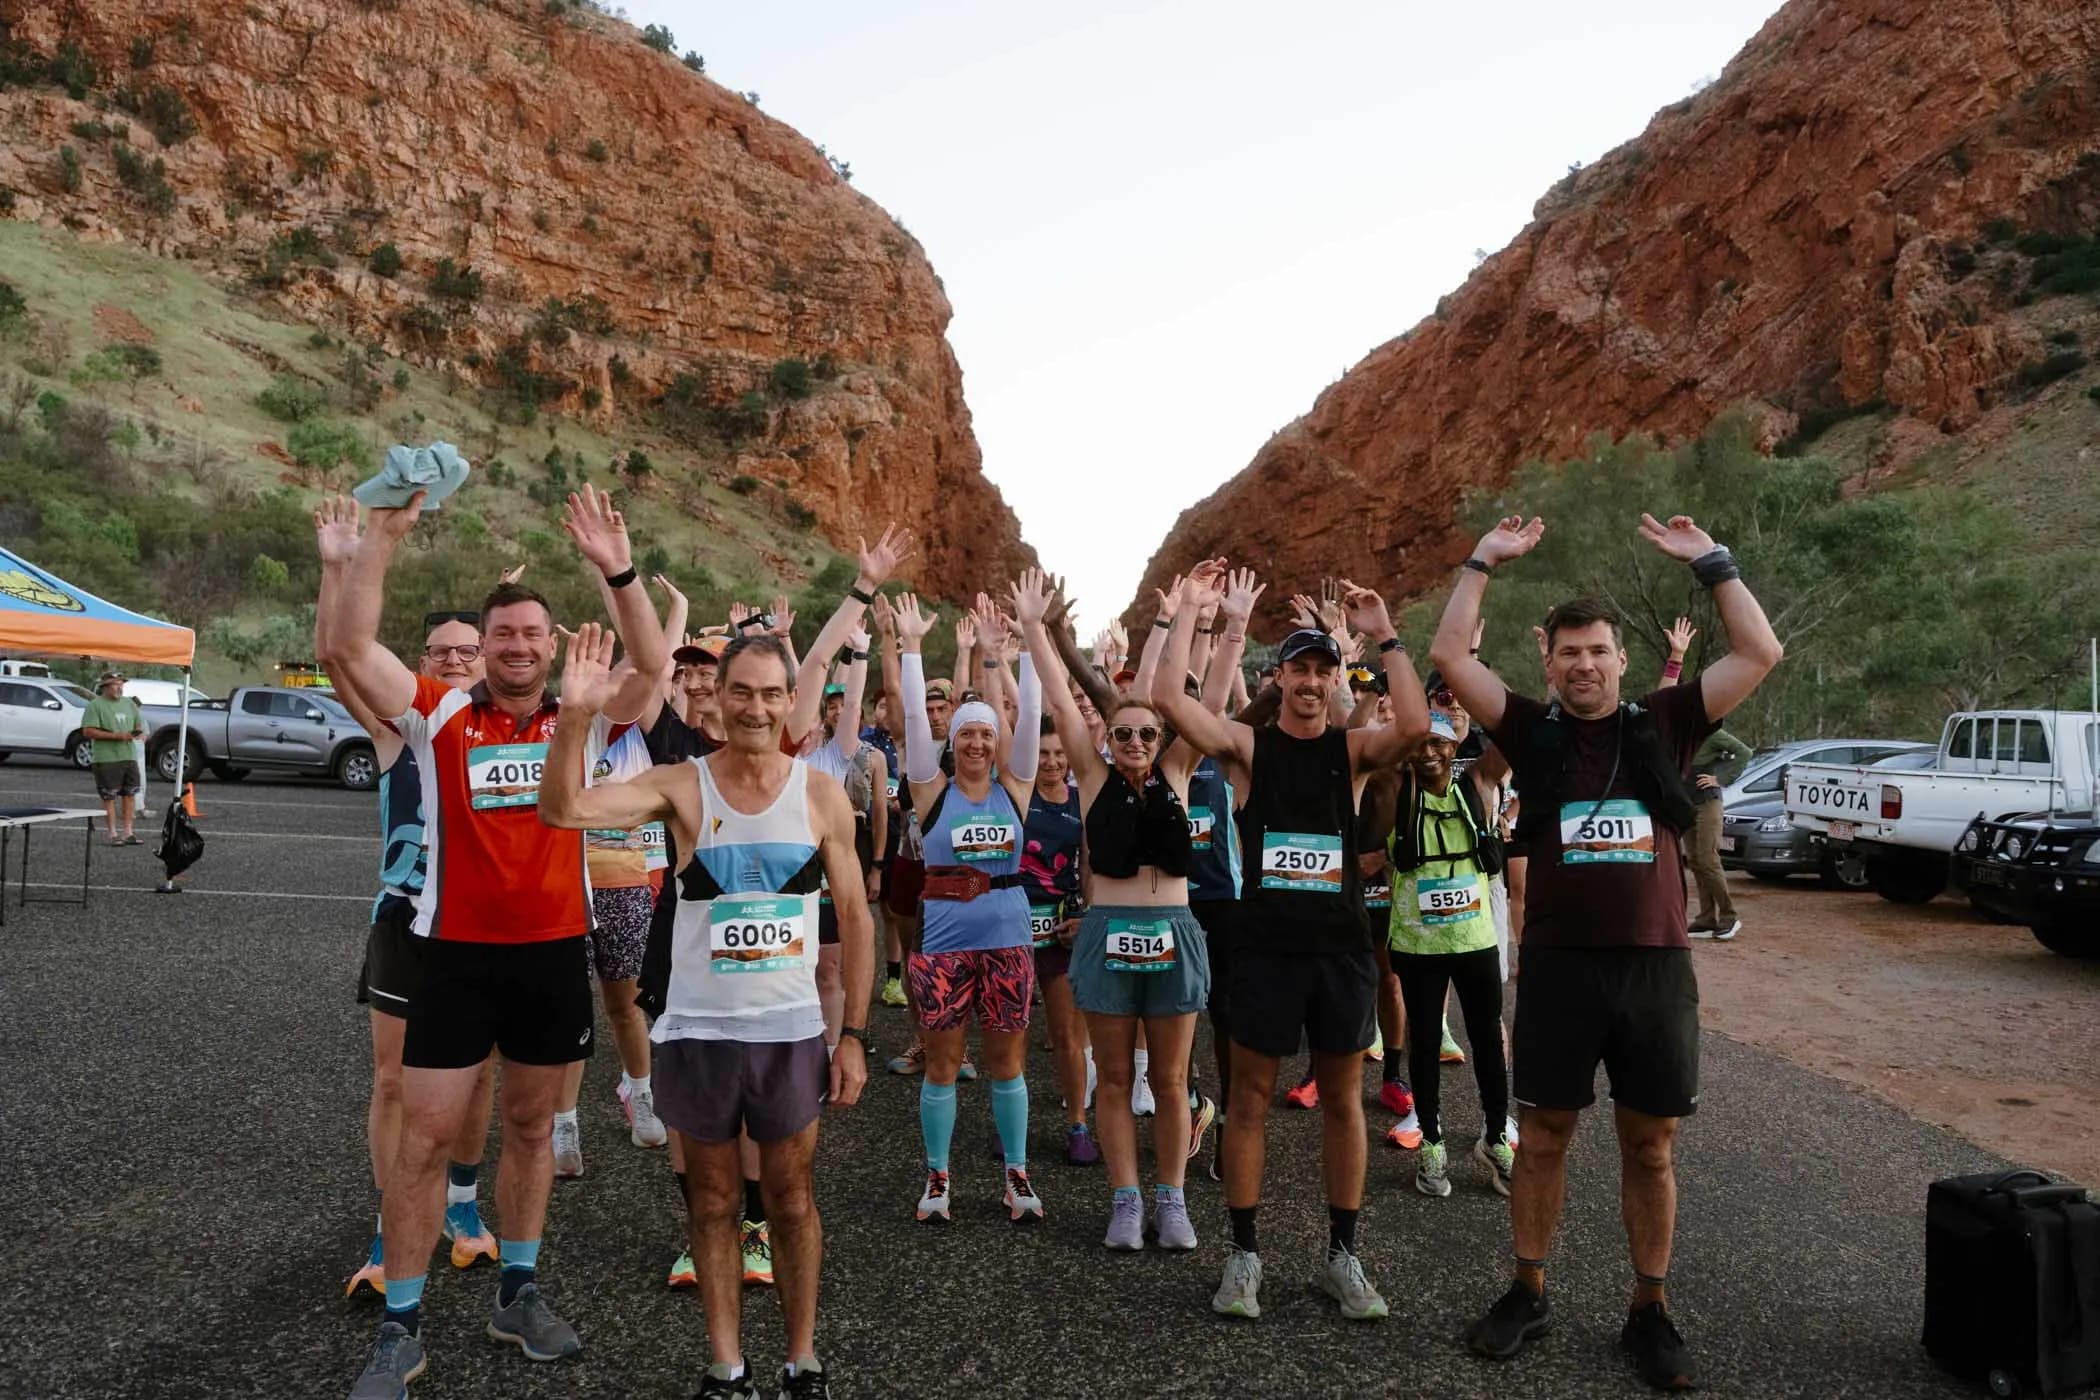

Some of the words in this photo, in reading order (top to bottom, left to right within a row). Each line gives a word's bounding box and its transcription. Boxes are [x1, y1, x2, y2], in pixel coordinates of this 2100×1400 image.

[486, 762, 544, 784] 4018
[1799, 785, 1869, 811] TOYOTA
[962, 827, 1007, 843] 4507
[1581, 819, 1634, 841] 5011
[1275, 851, 1330, 872] 2507
[1430, 890, 1471, 908] 5521
[724, 922, 792, 947] 6006
[1119, 936, 1164, 953] 5514
